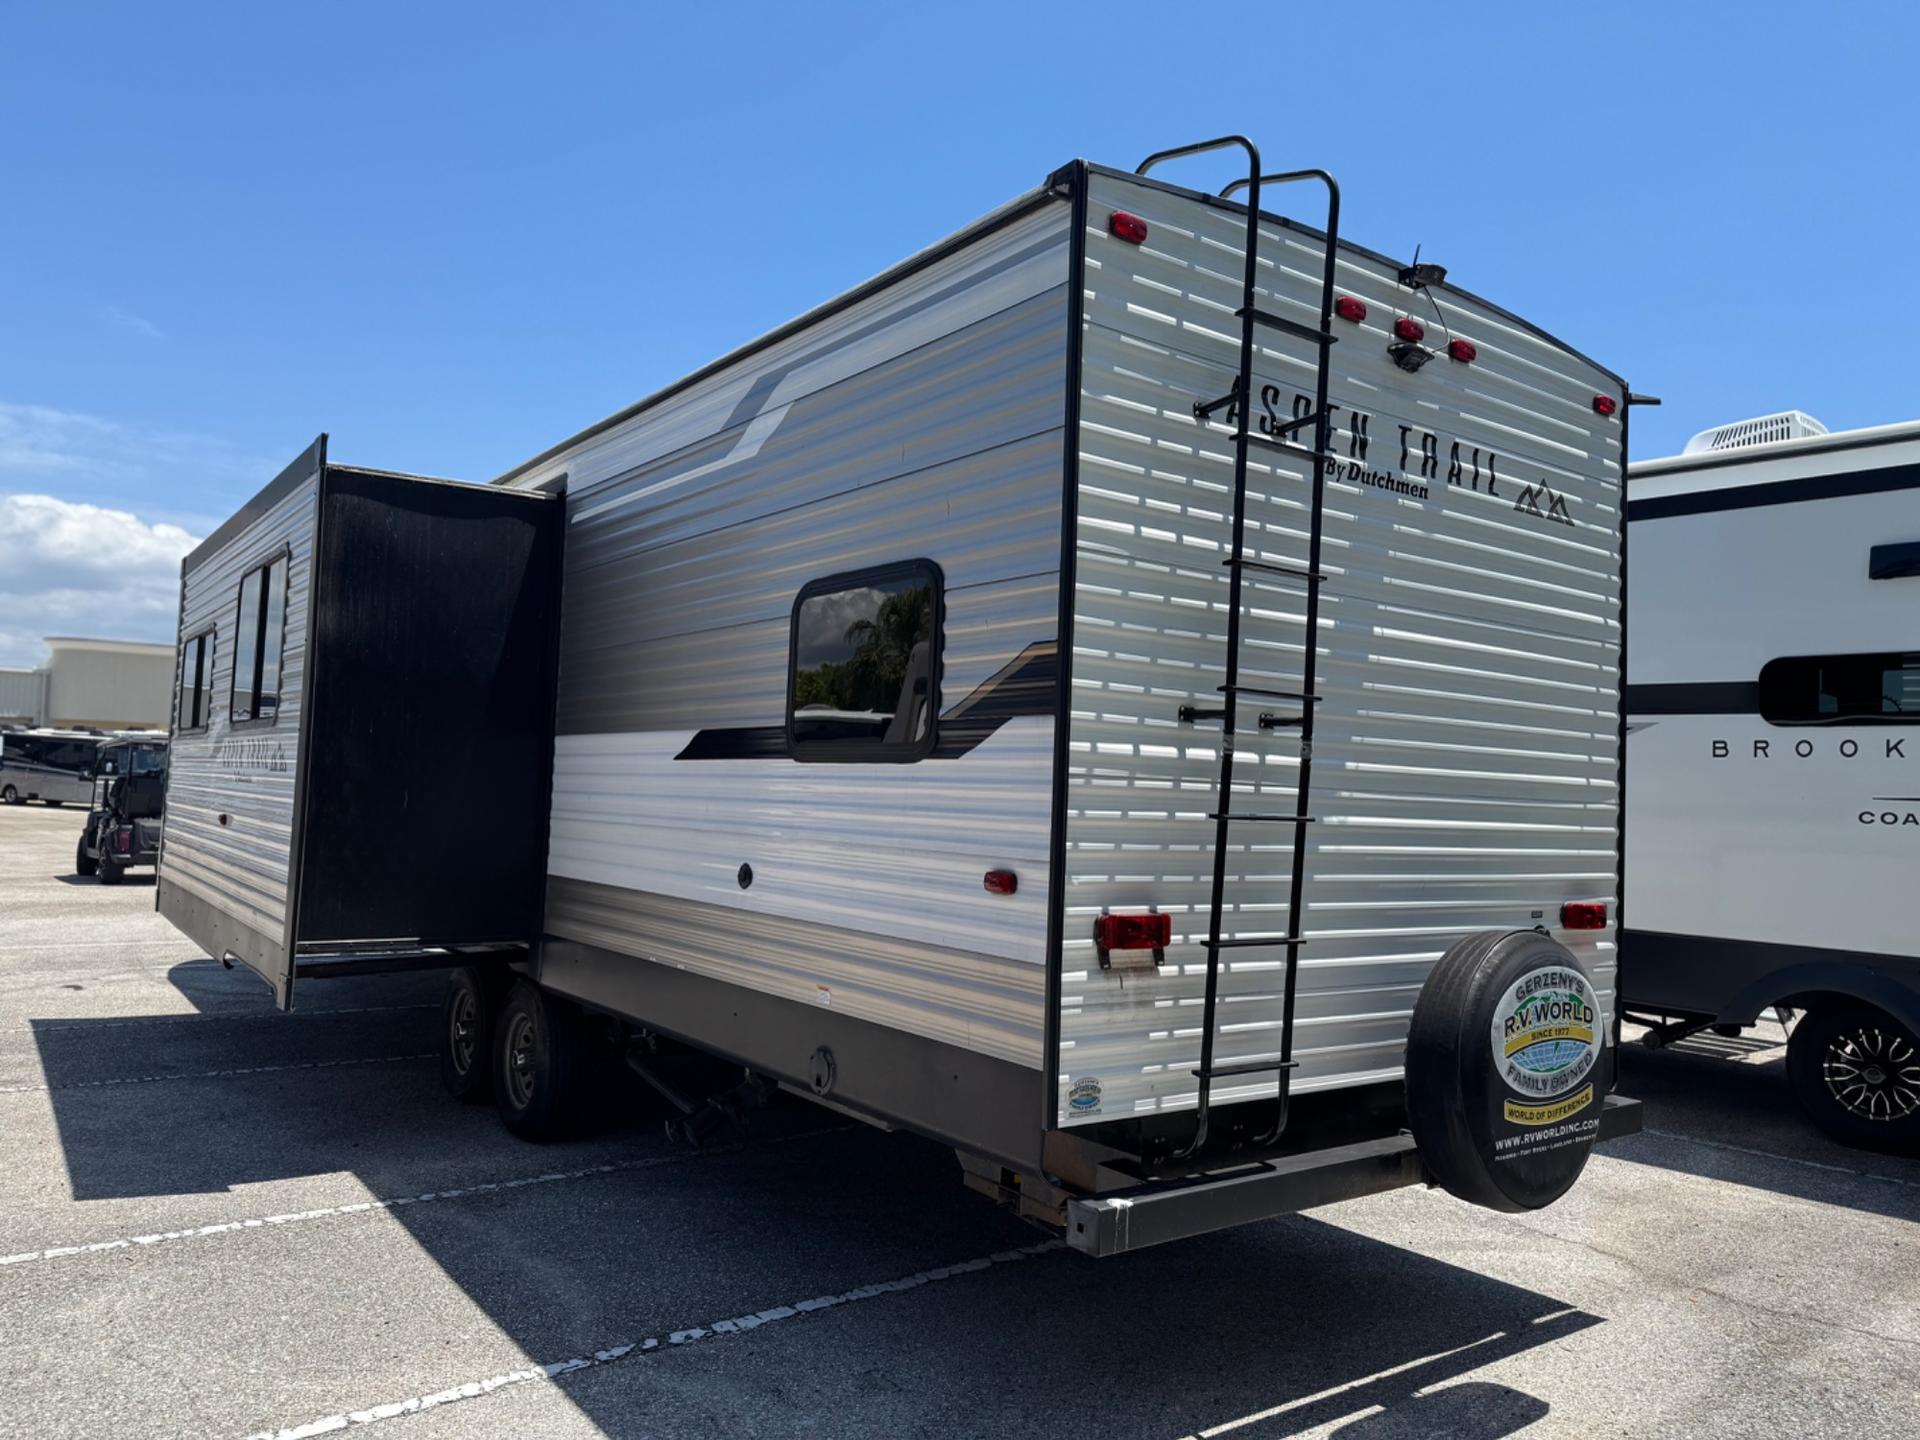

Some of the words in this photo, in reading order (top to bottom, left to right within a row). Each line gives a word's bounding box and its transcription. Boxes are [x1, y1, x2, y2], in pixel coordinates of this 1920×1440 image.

[1398, 424, 1499, 497] TRAIL
[1325, 459, 1346, 483] By
[1347, 462, 1429, 500] Dutchmen
[1712, 739, 1905, 758] BROOK
[1858, 811, 1920, 826] COA
[1515, 972, 1585, 1002] GERZENY'S
[1504, 1008, 1532, 1038] R.V.
[1534, 1002, 1594, 1024] WORLD
[1531, 1028, 1553, 1041] SINCE
[1507, 1063, 1549, 1091] FAMILY
[1551, 1050, 1594, 1092] OWNED
[1508, 1107, 1535, 1120] WORLD
[1536, 1111, 1546, 1120] OF
[1547, 1092, 1590, 1119] DIFFERENCE
[1495, 1117, 1600, 1151] WWW.RVWORLDINC.COM
